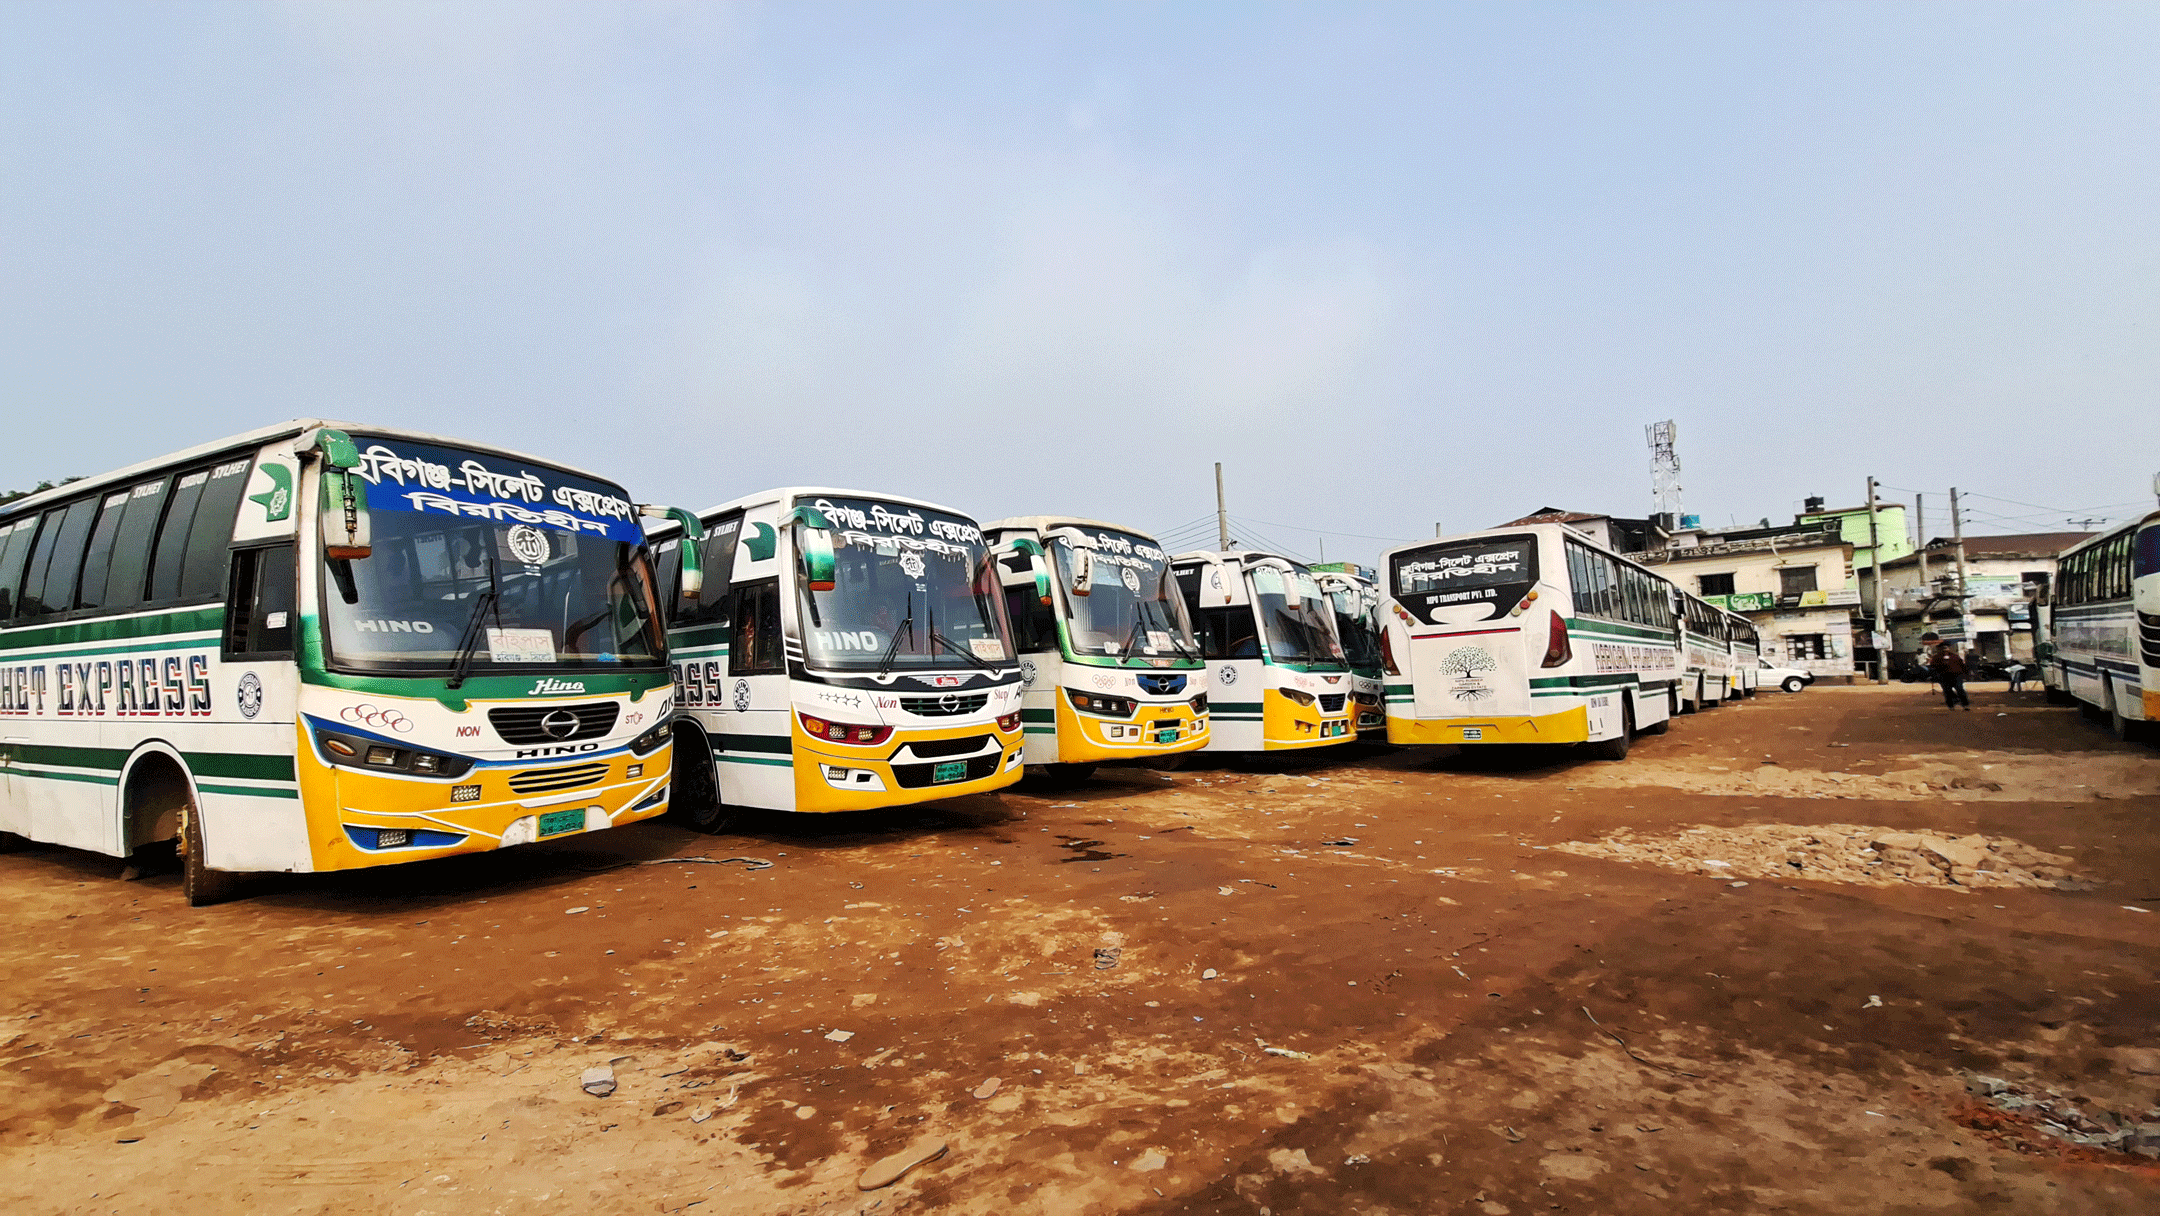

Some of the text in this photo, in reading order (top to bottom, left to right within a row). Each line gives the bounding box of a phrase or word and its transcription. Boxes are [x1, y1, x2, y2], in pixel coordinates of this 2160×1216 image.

[212, 460, 251, 479] SYLHET
[133, 482, 164, 498] SYLHET
[401, 491, 611, 537] বিরতিহীন
[815, 499, 924, 536] বিগঞ্জ-সিলেট
[1439, 591, 1471, 603] TRANSPORT
[355, 619, 434, 635] HINO
[814, 631, 879, 652] HINO
[0, 664, 46, 716] HET
[56, 654, 213, 716] EXPRESS
[528, 678, 586, 695] Hino
[876, 696, 897, 709] Non
[456, 711, 644, 738] NON STOP
[516, 743, 599, 758] HINO
